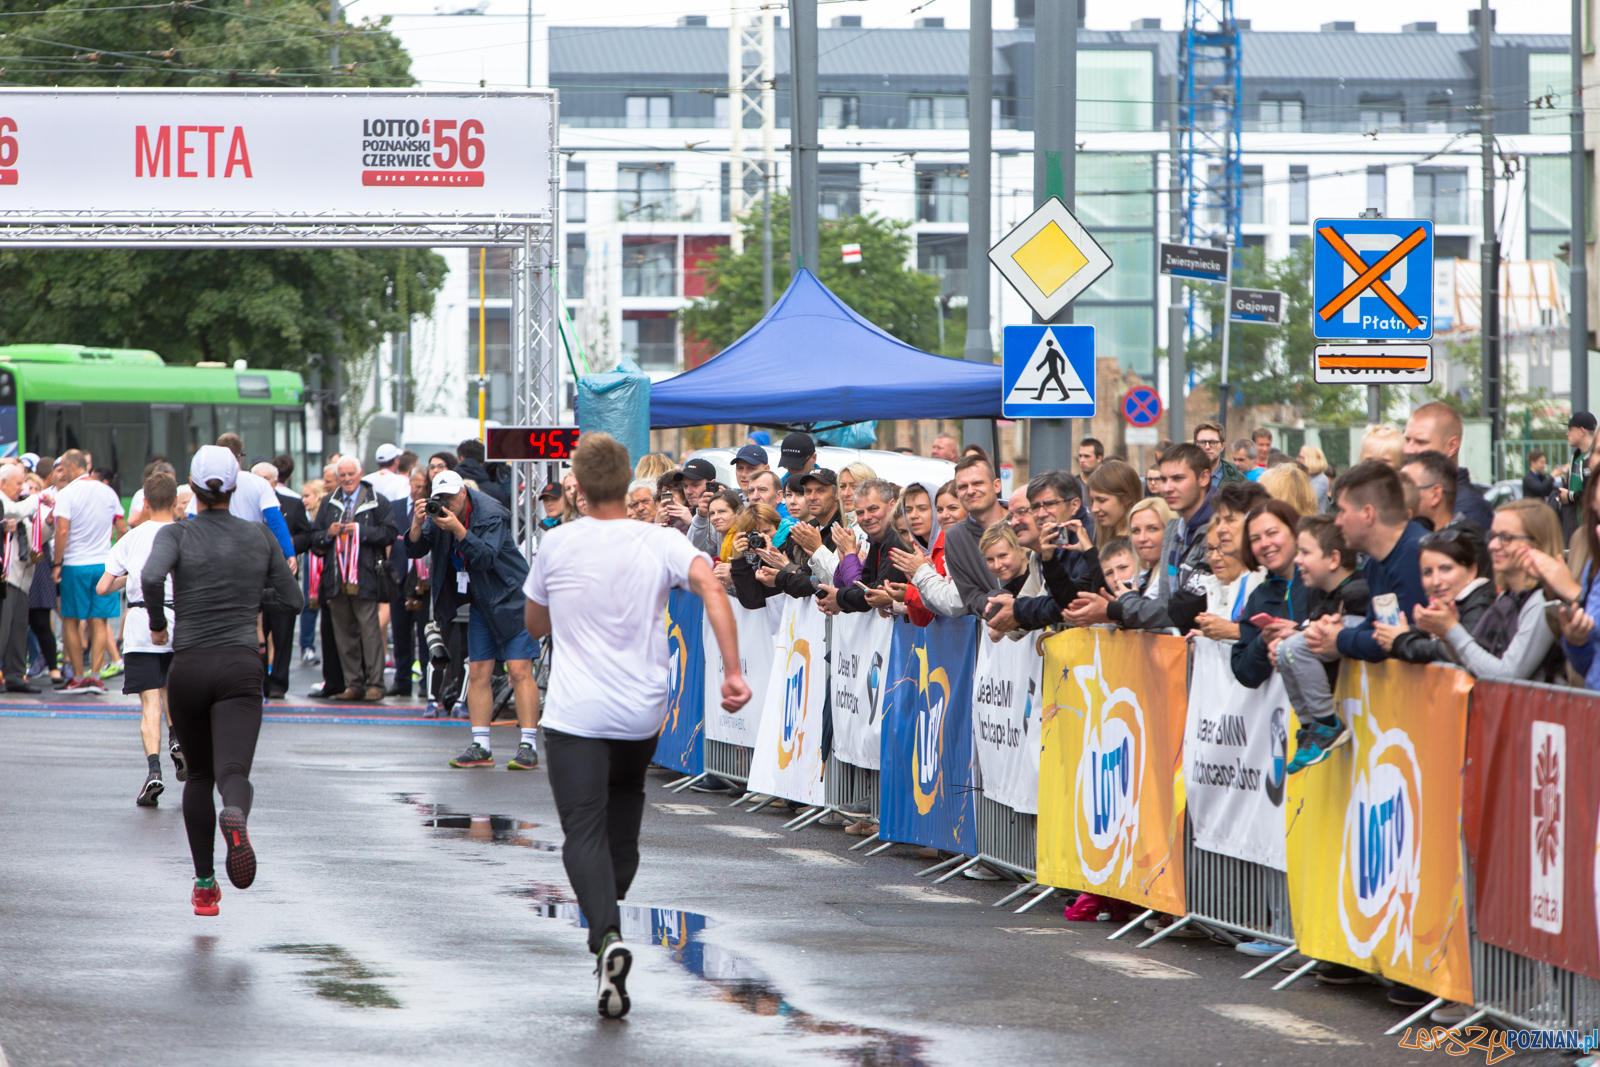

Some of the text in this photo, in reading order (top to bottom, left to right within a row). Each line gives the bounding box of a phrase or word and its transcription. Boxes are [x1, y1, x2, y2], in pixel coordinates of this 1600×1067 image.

[363, 119, 420, 138] LOTTO
[135, 125, 253, 178] META
[362, 138, 431, 152] POZNAŃSKI
[362, 154, 431, 167] CZERWIEC
[1165, 253, 1221, 271] Zwierzyniecka
[1236, 299, 1276, 313] Gajowa
[1363, 315, 1411, 333] Płatn
[1092, 736, 1129, 835] LOTTO
[1359, 786, 1405, 899] LOTTO
